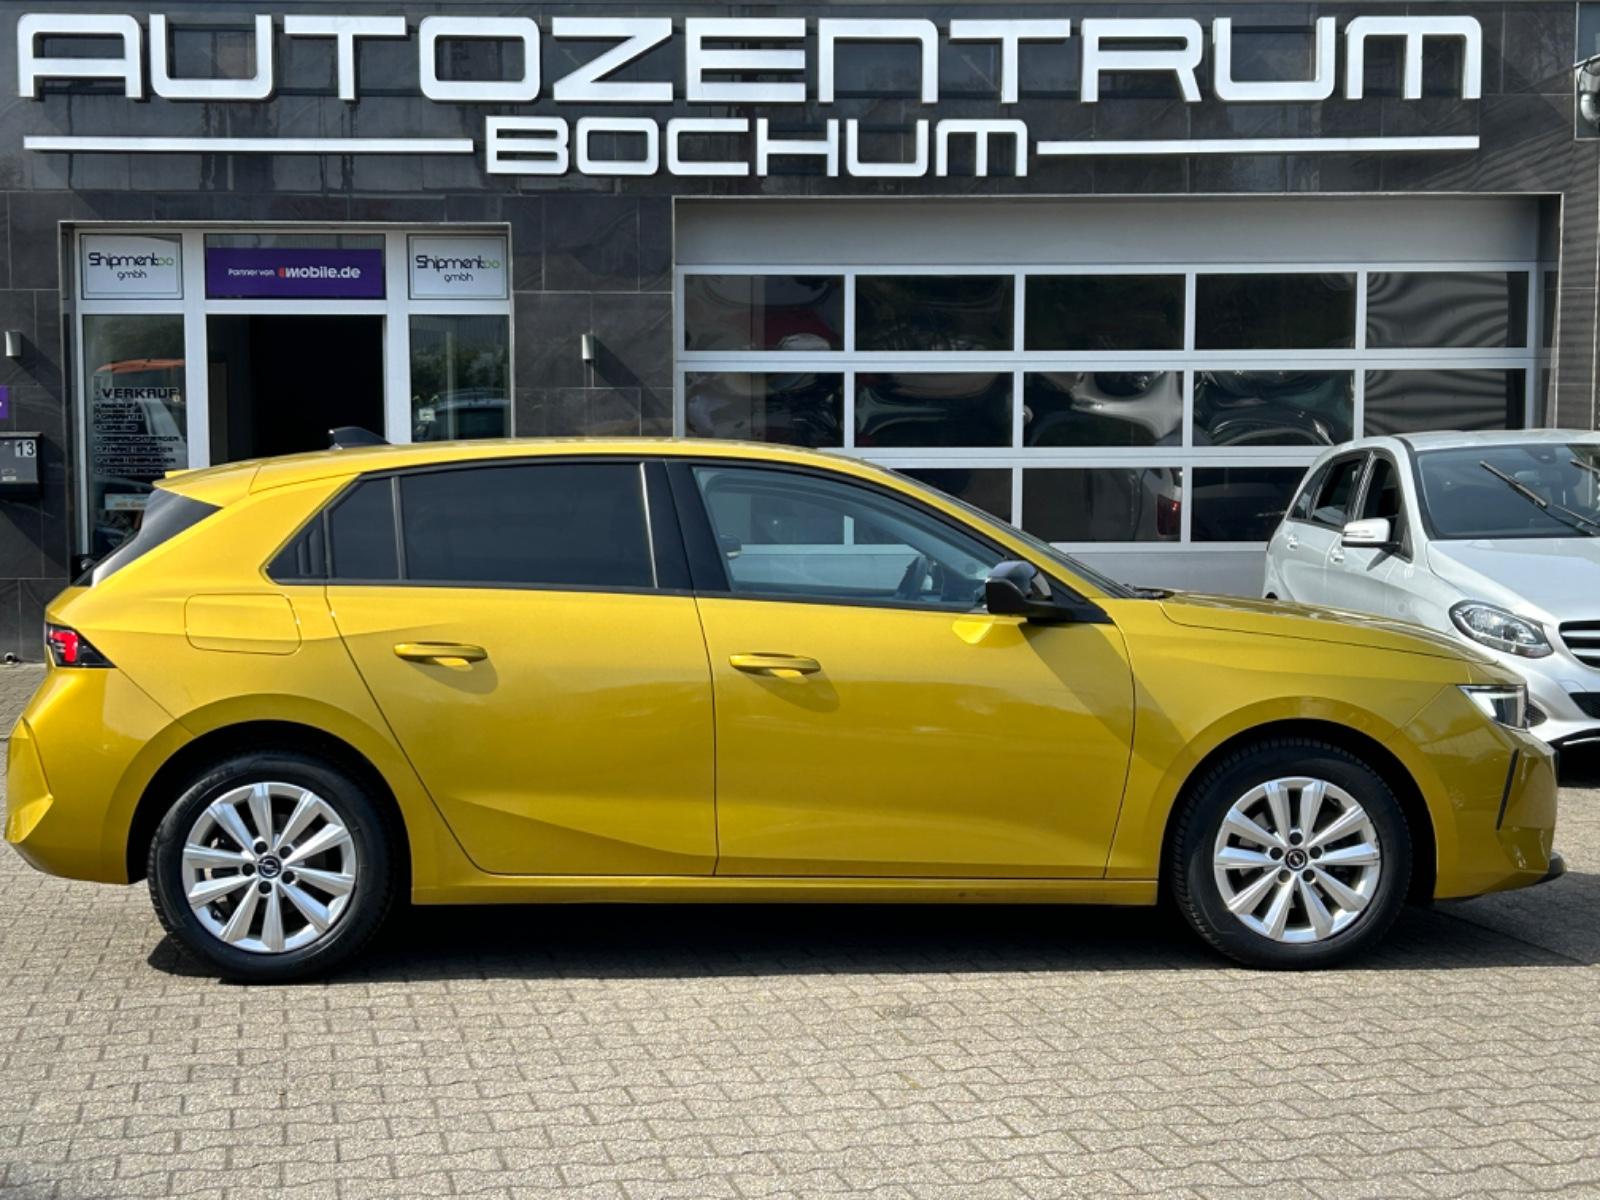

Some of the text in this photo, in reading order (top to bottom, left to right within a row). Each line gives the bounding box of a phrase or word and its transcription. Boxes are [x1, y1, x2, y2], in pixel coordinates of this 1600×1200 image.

[17, 14, 1481, 103] AUTOZENTRUM
[486, 115, 1028, 177] BOCHUM
[228, 267, 257, 276] Partner
[285, 266, 360, 279] mobile.de
[102, 387, 178, 399] VERKAUF
[17, 441, 34, 456] 13
